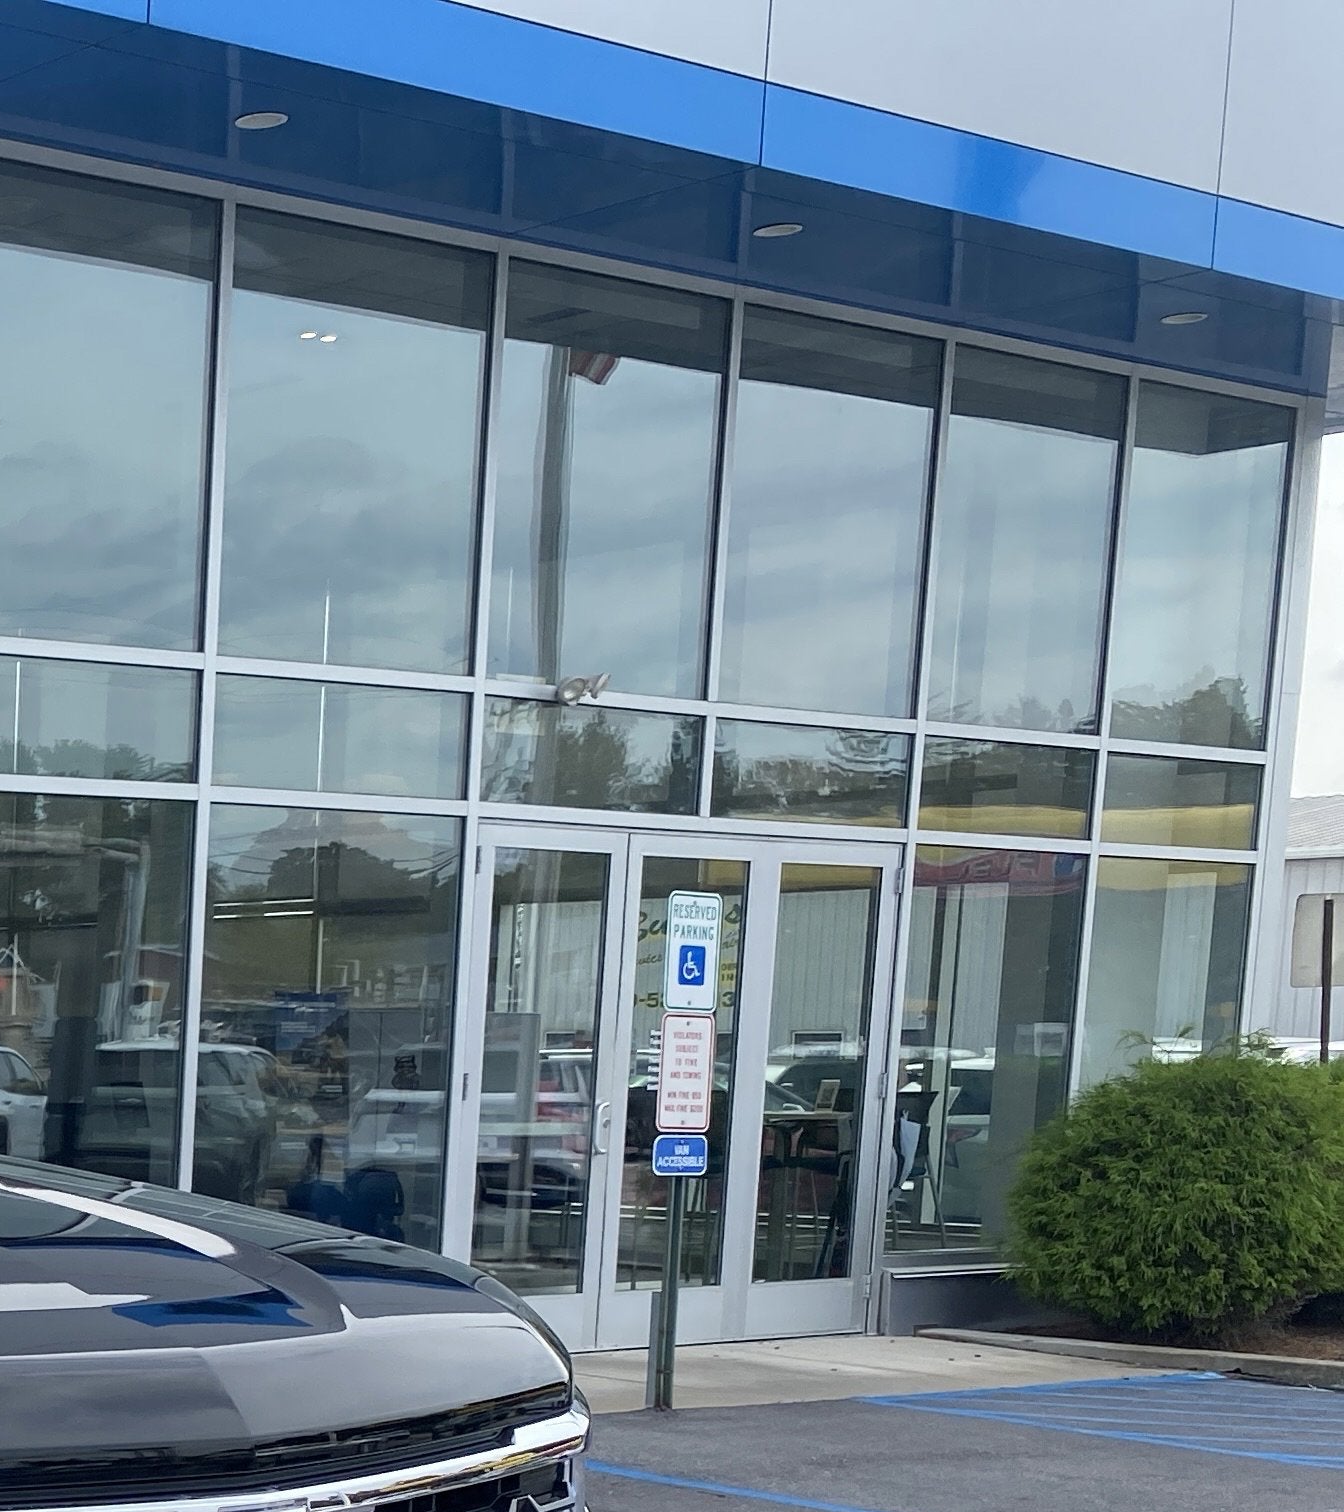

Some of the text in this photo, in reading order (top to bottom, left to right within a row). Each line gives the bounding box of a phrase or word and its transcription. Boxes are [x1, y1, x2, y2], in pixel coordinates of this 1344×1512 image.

[673, 903, 717, 921] RESERVED
[673, 923, 715, 941] PARKING
[673, 1032, 702, 1040] VIOLATORS
[684, 1057, 698, 1067] FINE
[670, 1071, 702, 1080] AND TOWING
[678, 1091, 689, 1099] FINE
[676, 1104, 688, 1113] FINE
[674, 1145, 690, 1156] VAN
[656, 1156, 705, 1168] ACCESSIBLE
